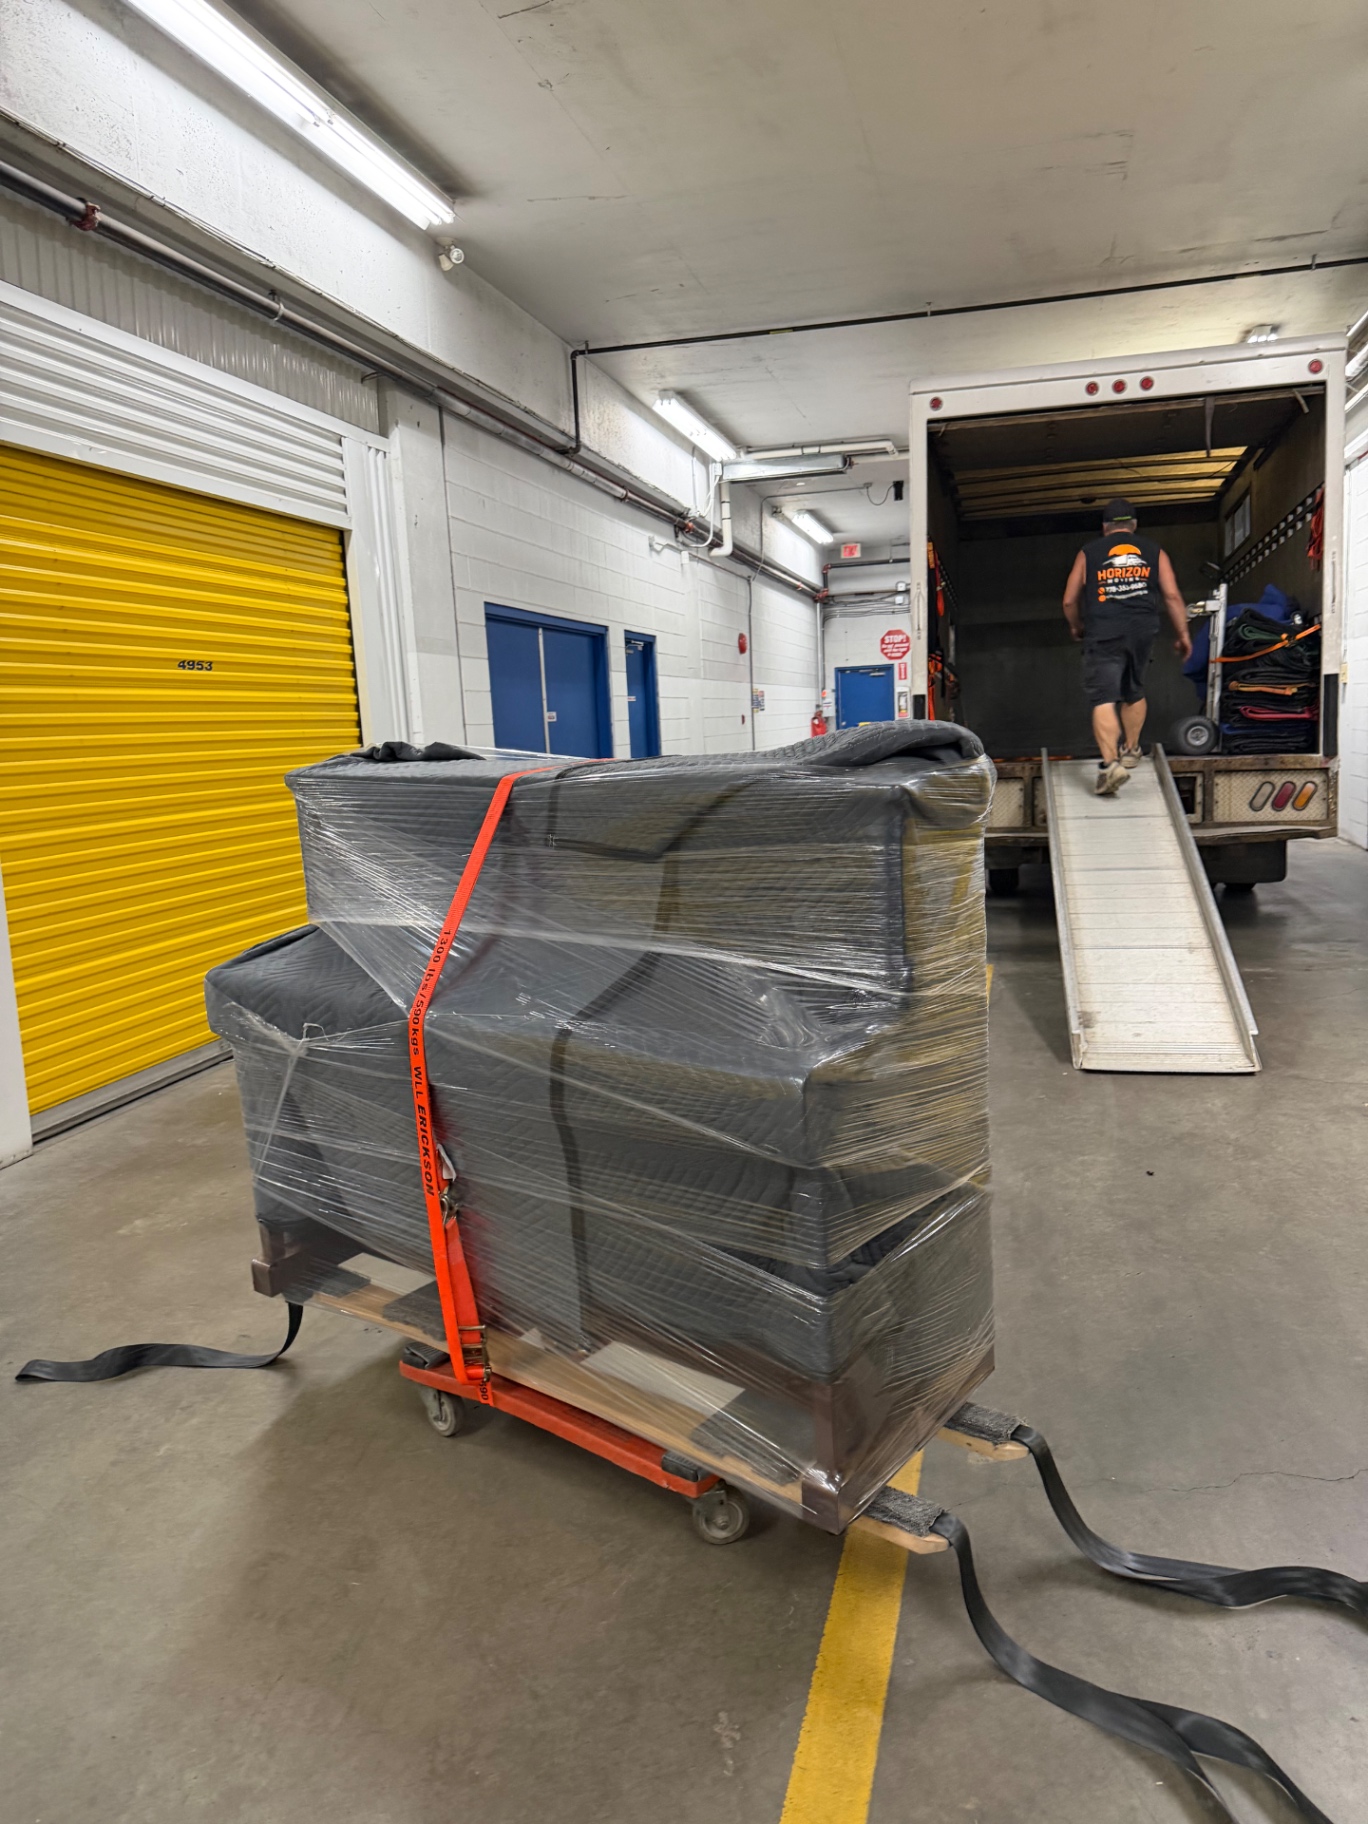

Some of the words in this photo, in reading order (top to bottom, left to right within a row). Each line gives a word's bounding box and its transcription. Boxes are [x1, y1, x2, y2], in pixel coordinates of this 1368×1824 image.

[1097, 566, 1151, 581] HORIZON
[177, 660, 213, 671] 4953
[433, 929, 451, 963] 1300
[413, 1066, 423, 1099] WLL
[417, 1104, 435, 1196] ERICKSON
